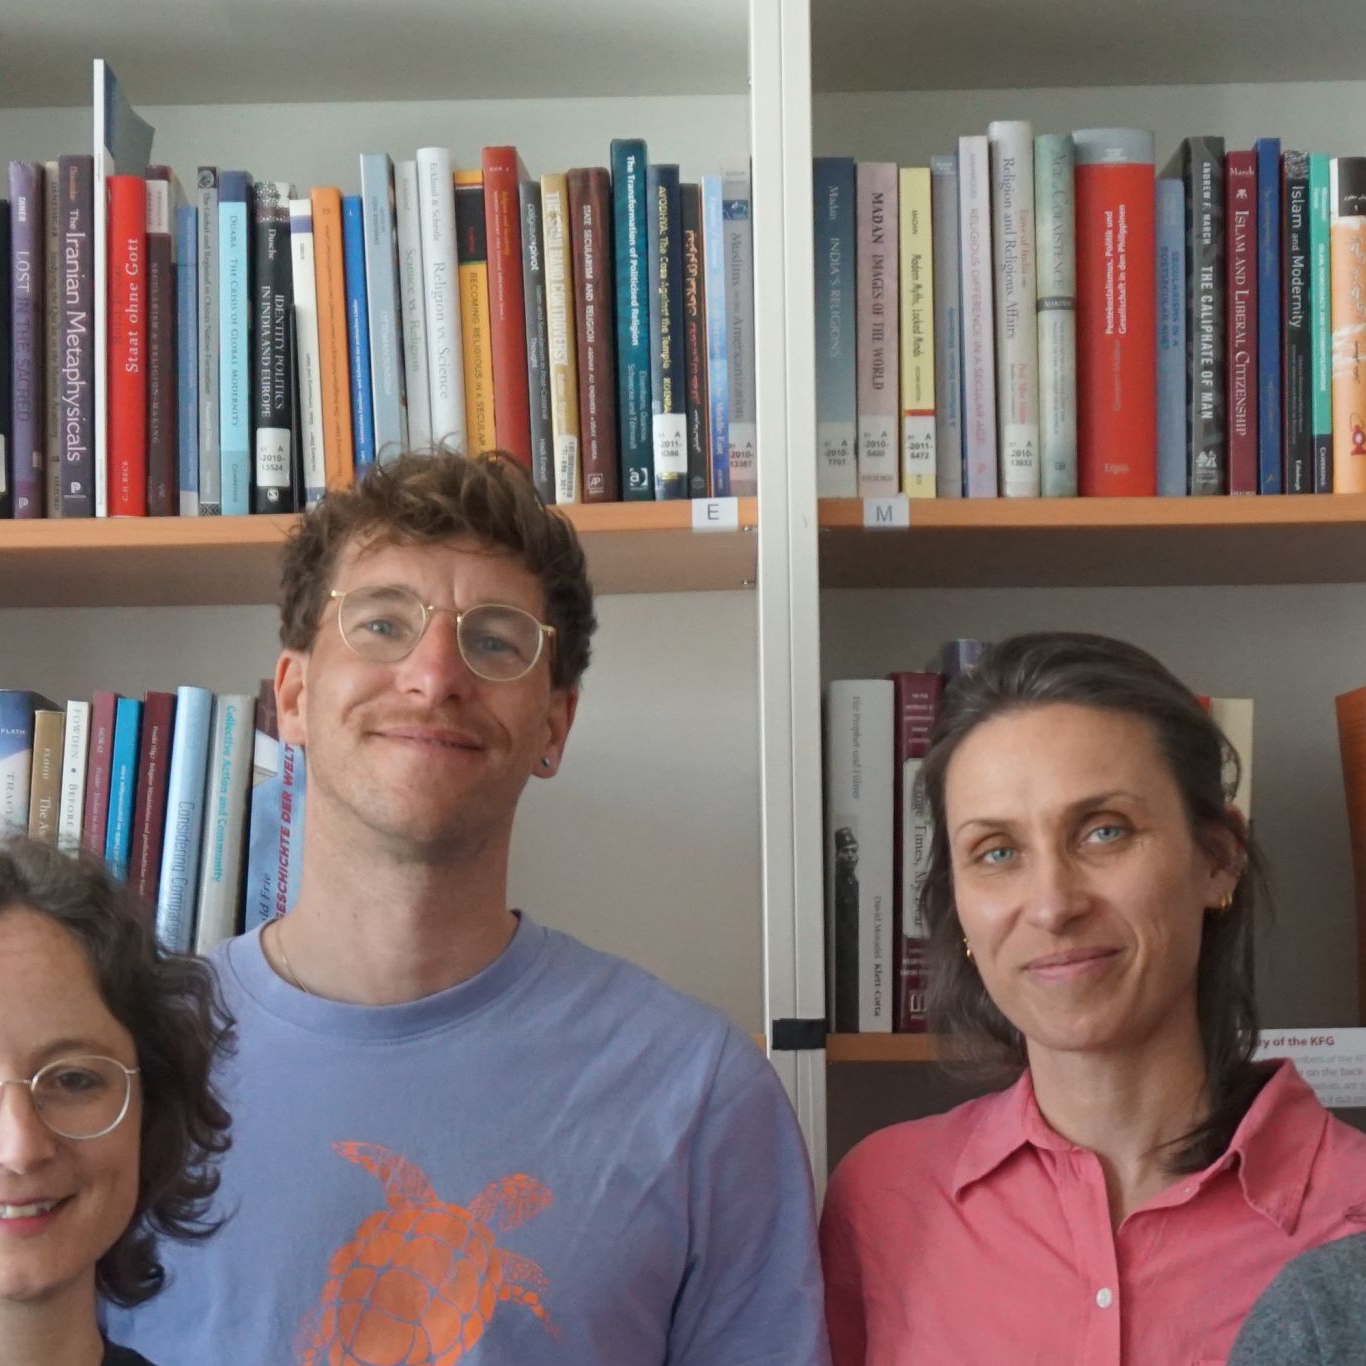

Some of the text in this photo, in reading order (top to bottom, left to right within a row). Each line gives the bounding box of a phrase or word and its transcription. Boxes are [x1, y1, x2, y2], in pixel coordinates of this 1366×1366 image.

[626, 155, 640, 345] The Transformation of Politicised Religion
[1290, 185, 1305, 228] Islam
[1290, 232, 1300, 250] and
[14, 250, 30, 422] LOST IN THE SACRED
[62, 208, 86, 461] The Iranian Metaphysicals
[124, 238, 140, 372] Staat ohne Gott
[260, 284, 271, 417] IN INDIA AND EUROPE
[273, 294, 285, 409] IDENTITY POLITICS
[429, 261, 452, 399] Religion vs. Science
[871, 192, 884, 390] MADAN IMAGES OF THE WORLD
[1200, 265, 1214, 419] THE CALIPHATE OF MAN
[1234, 210, 1250, 436] ISLAM AND LIBERAL CITIZENSHIP
[1288, 254, 1305, 328] Modernity
[707, 503, 719, 521] E
[876, 505, 893, 522] M
[211, 704, 236, 882] Collective Action and Community
